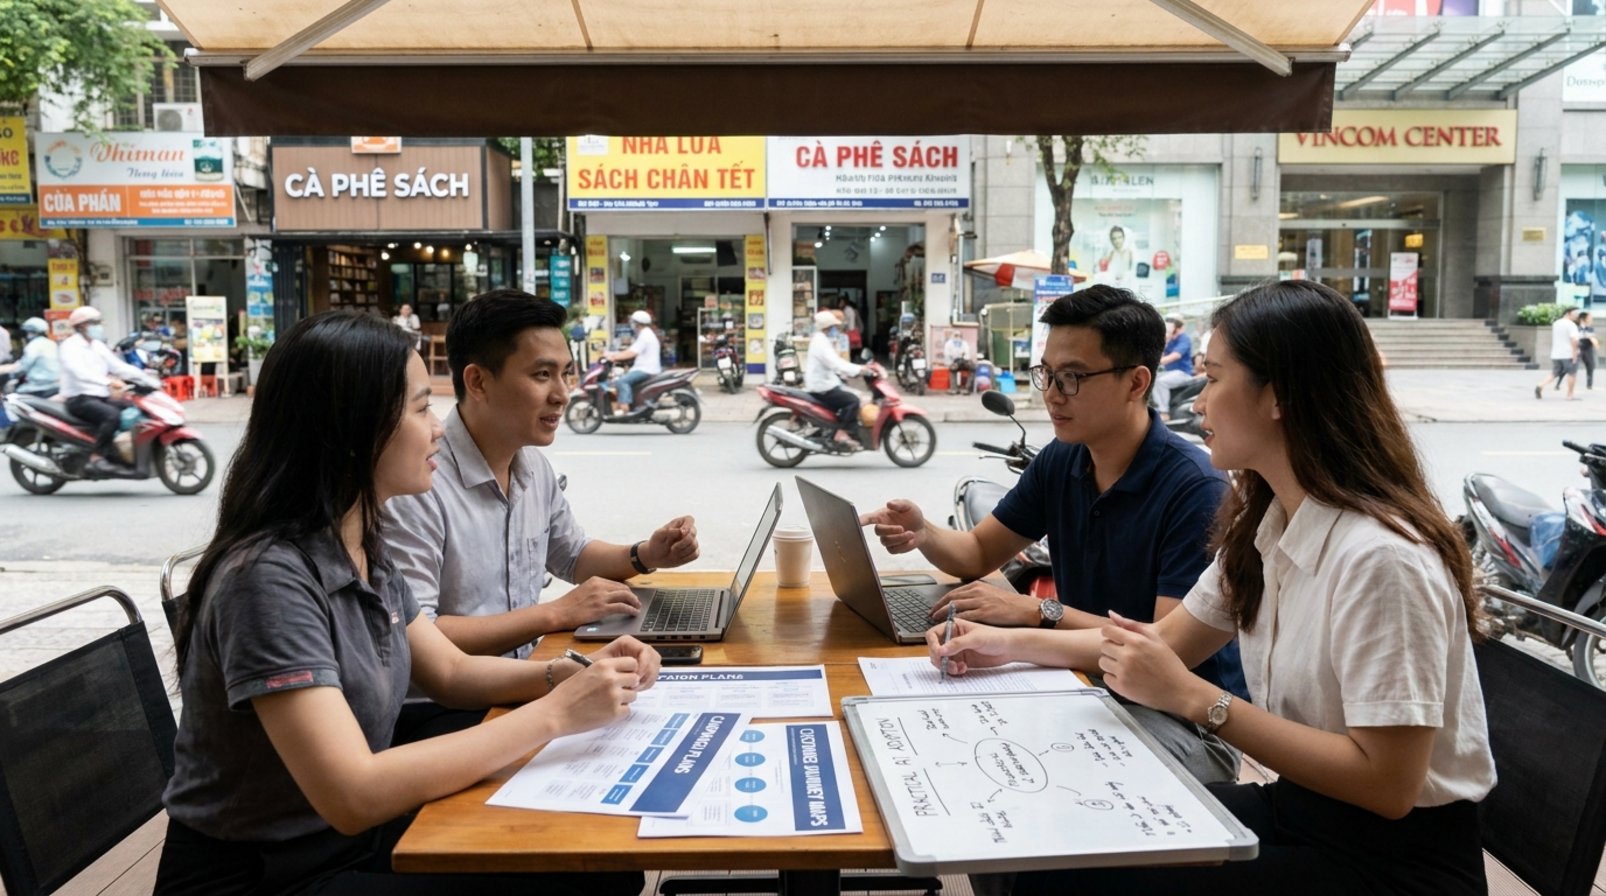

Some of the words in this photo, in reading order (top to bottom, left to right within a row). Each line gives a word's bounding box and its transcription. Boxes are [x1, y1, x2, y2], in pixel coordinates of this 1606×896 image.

[1295, 126, 1398, 147] VINCOM
[1404, 126, 1502, 147] CENTER
[796, 140, 828, 168] CÀ
[836, 140, 883, 168] PHÊ
[892, 140, 958, 168] SÁCH
[284, 167, 325, 198] CÀ
[331, 167, 387, 198] PHÊ
[393, 167, 469, 198] SÁCH
[578, 163, 638, 189] SÁCH
[647, 163, 709, 189] CHÂN
[717, 161, 755, 189] TẾT
